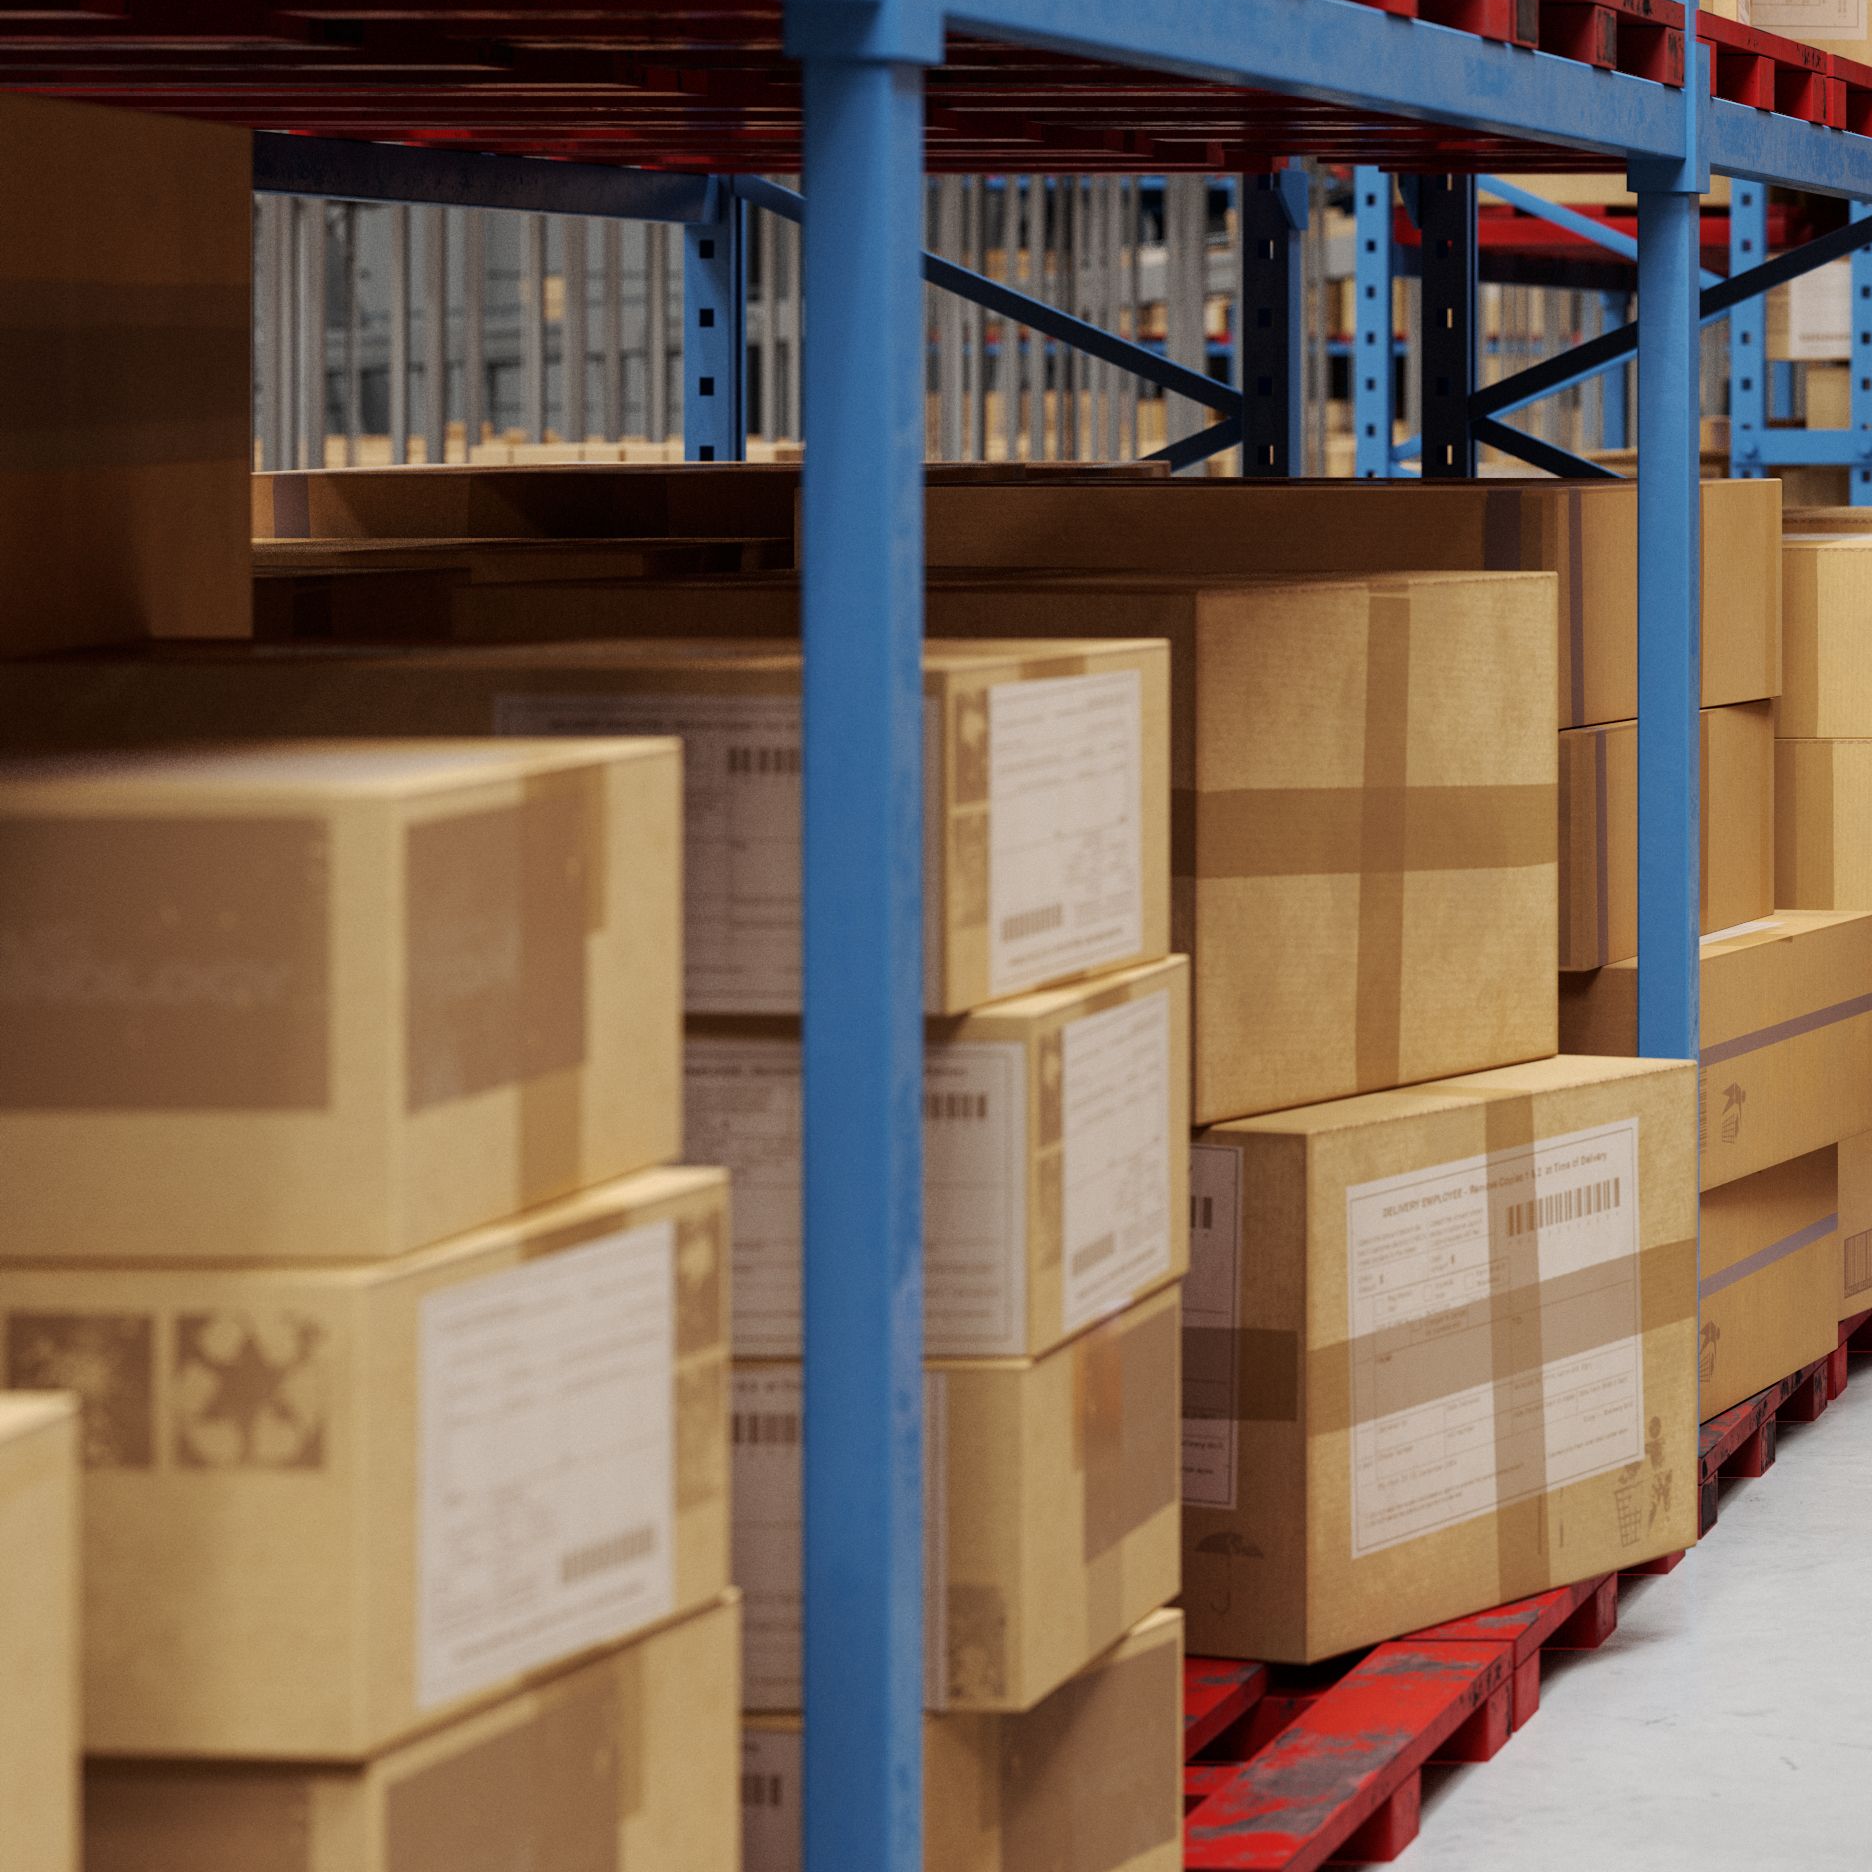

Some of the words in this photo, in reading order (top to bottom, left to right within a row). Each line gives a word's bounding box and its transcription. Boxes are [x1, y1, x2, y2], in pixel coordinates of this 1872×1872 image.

[1382, 1200, 1419, 1218] DELIVERY
[1421, 1189, 1462, 1208] EMPLOYEE
[1581, 1152, 1607, 1166] Delivery
